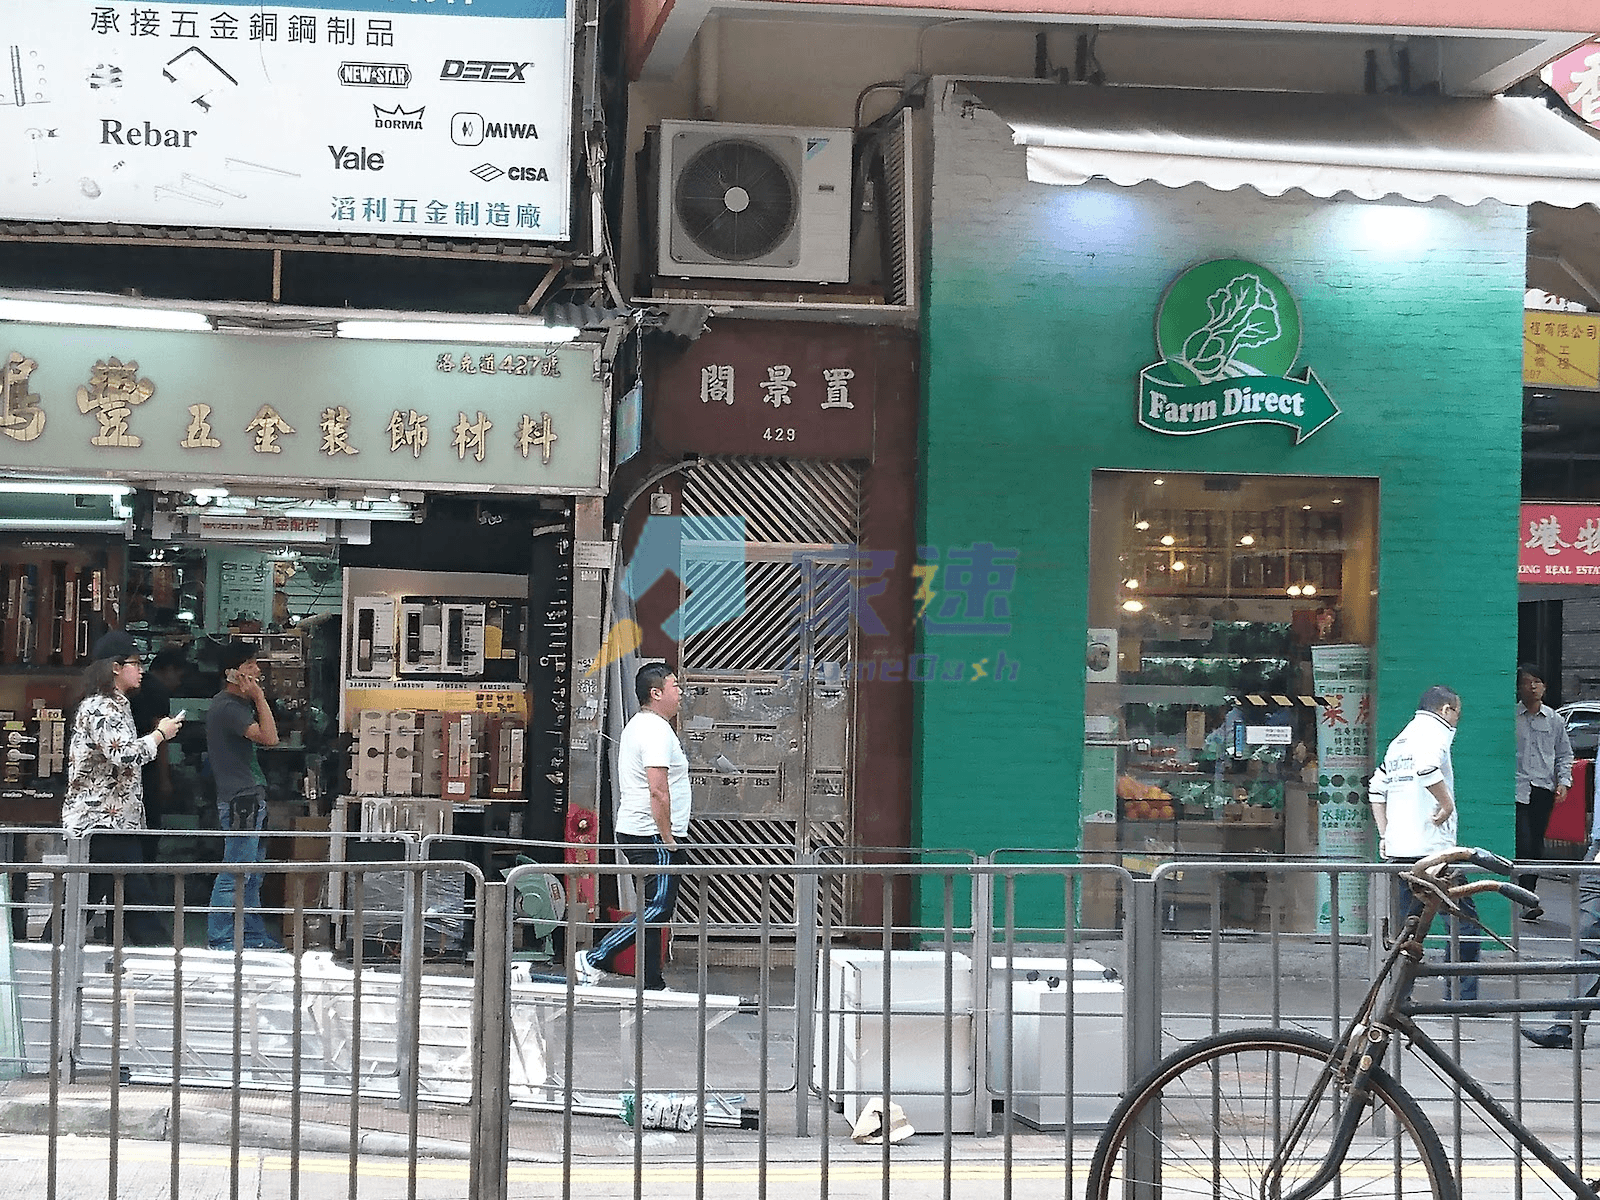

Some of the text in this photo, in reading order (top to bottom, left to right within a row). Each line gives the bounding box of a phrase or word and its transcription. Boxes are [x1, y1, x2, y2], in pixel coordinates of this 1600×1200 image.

[91, 7, 394, 47] 承接五金銅鋼制品
[344, 65, 405, 85] NEW STAR
[440, 60, 530, 81] DETEX
[100, 118, 198, 148] Rebar
[375, 119, 424, 130] DORMA
[485, 122, 539, 139] MIWA
[328, 145, 385, 171] Yale
[507, 166, 549, 182] CISA
[1149, 387, 1305, 422] Farm Direct
[763, 427, 796, 441] 429
[1518, 565, 1541, 574] ONG
[1545, 565, 1572, 575] REAL
